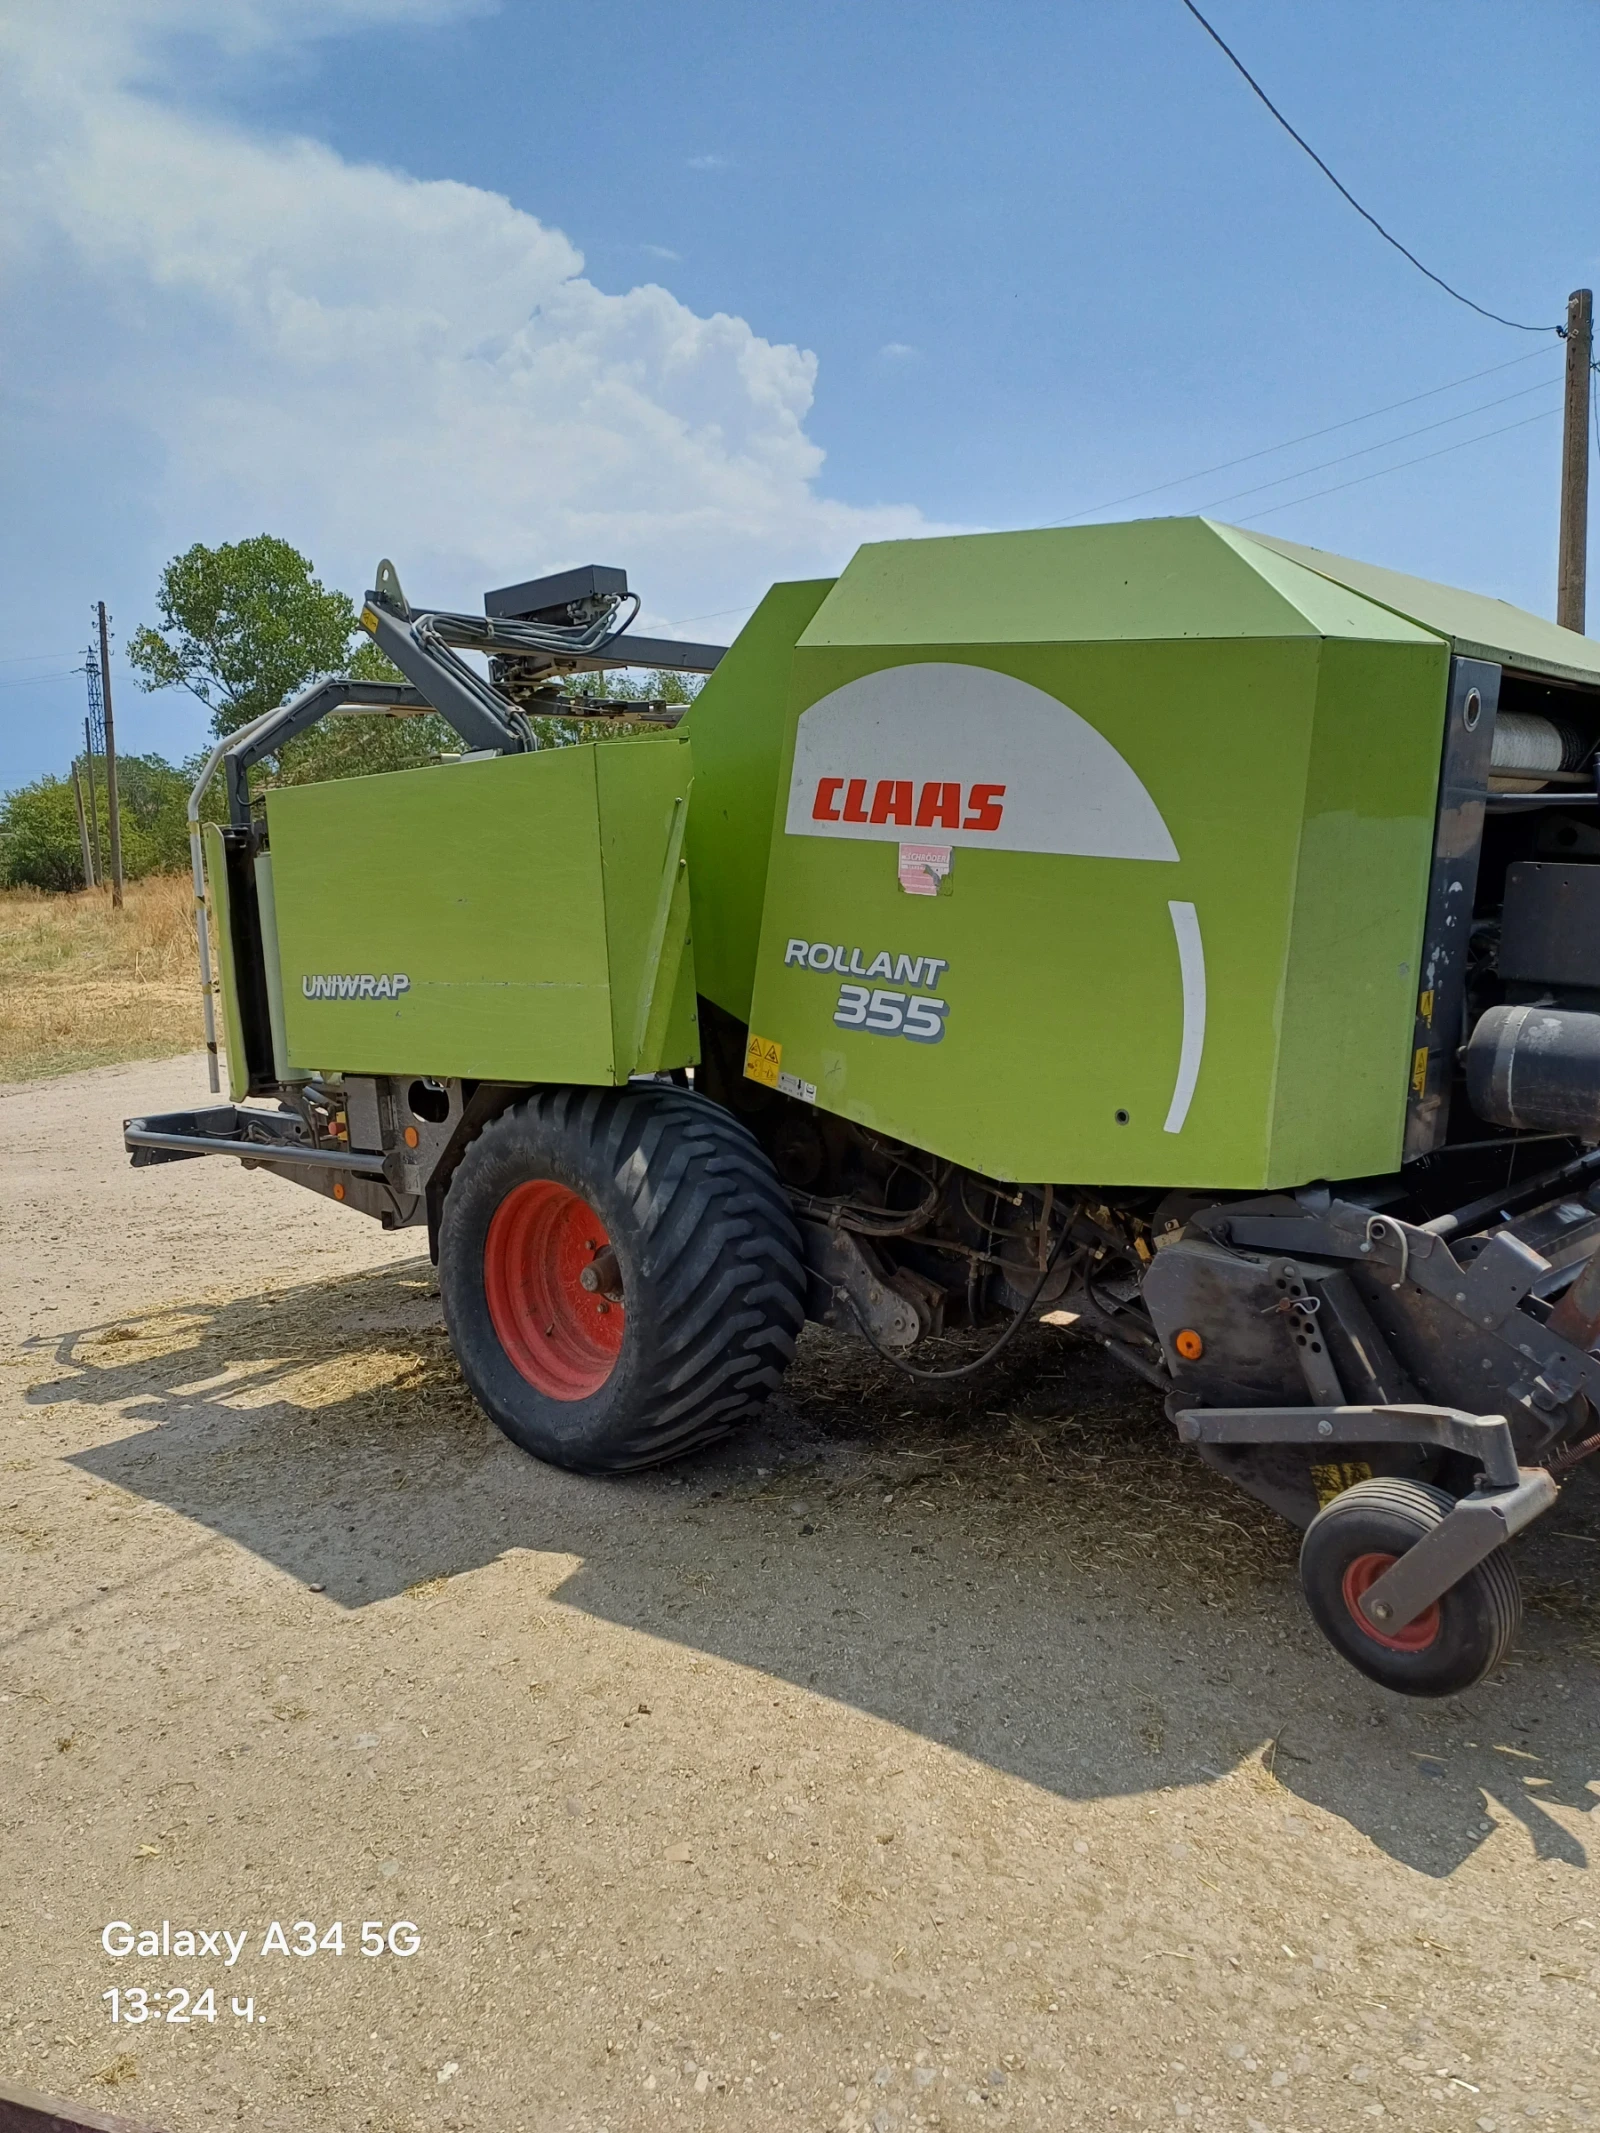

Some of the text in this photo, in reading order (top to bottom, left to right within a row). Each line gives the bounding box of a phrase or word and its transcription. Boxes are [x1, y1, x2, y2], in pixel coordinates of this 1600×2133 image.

[812, 777, 1006, 831] CLAAS
[302, 973, 410, 1000] UNIWRAP
[784, 938, 949, 989] ROLLANT
[833, 983, 949, 1043] 355
